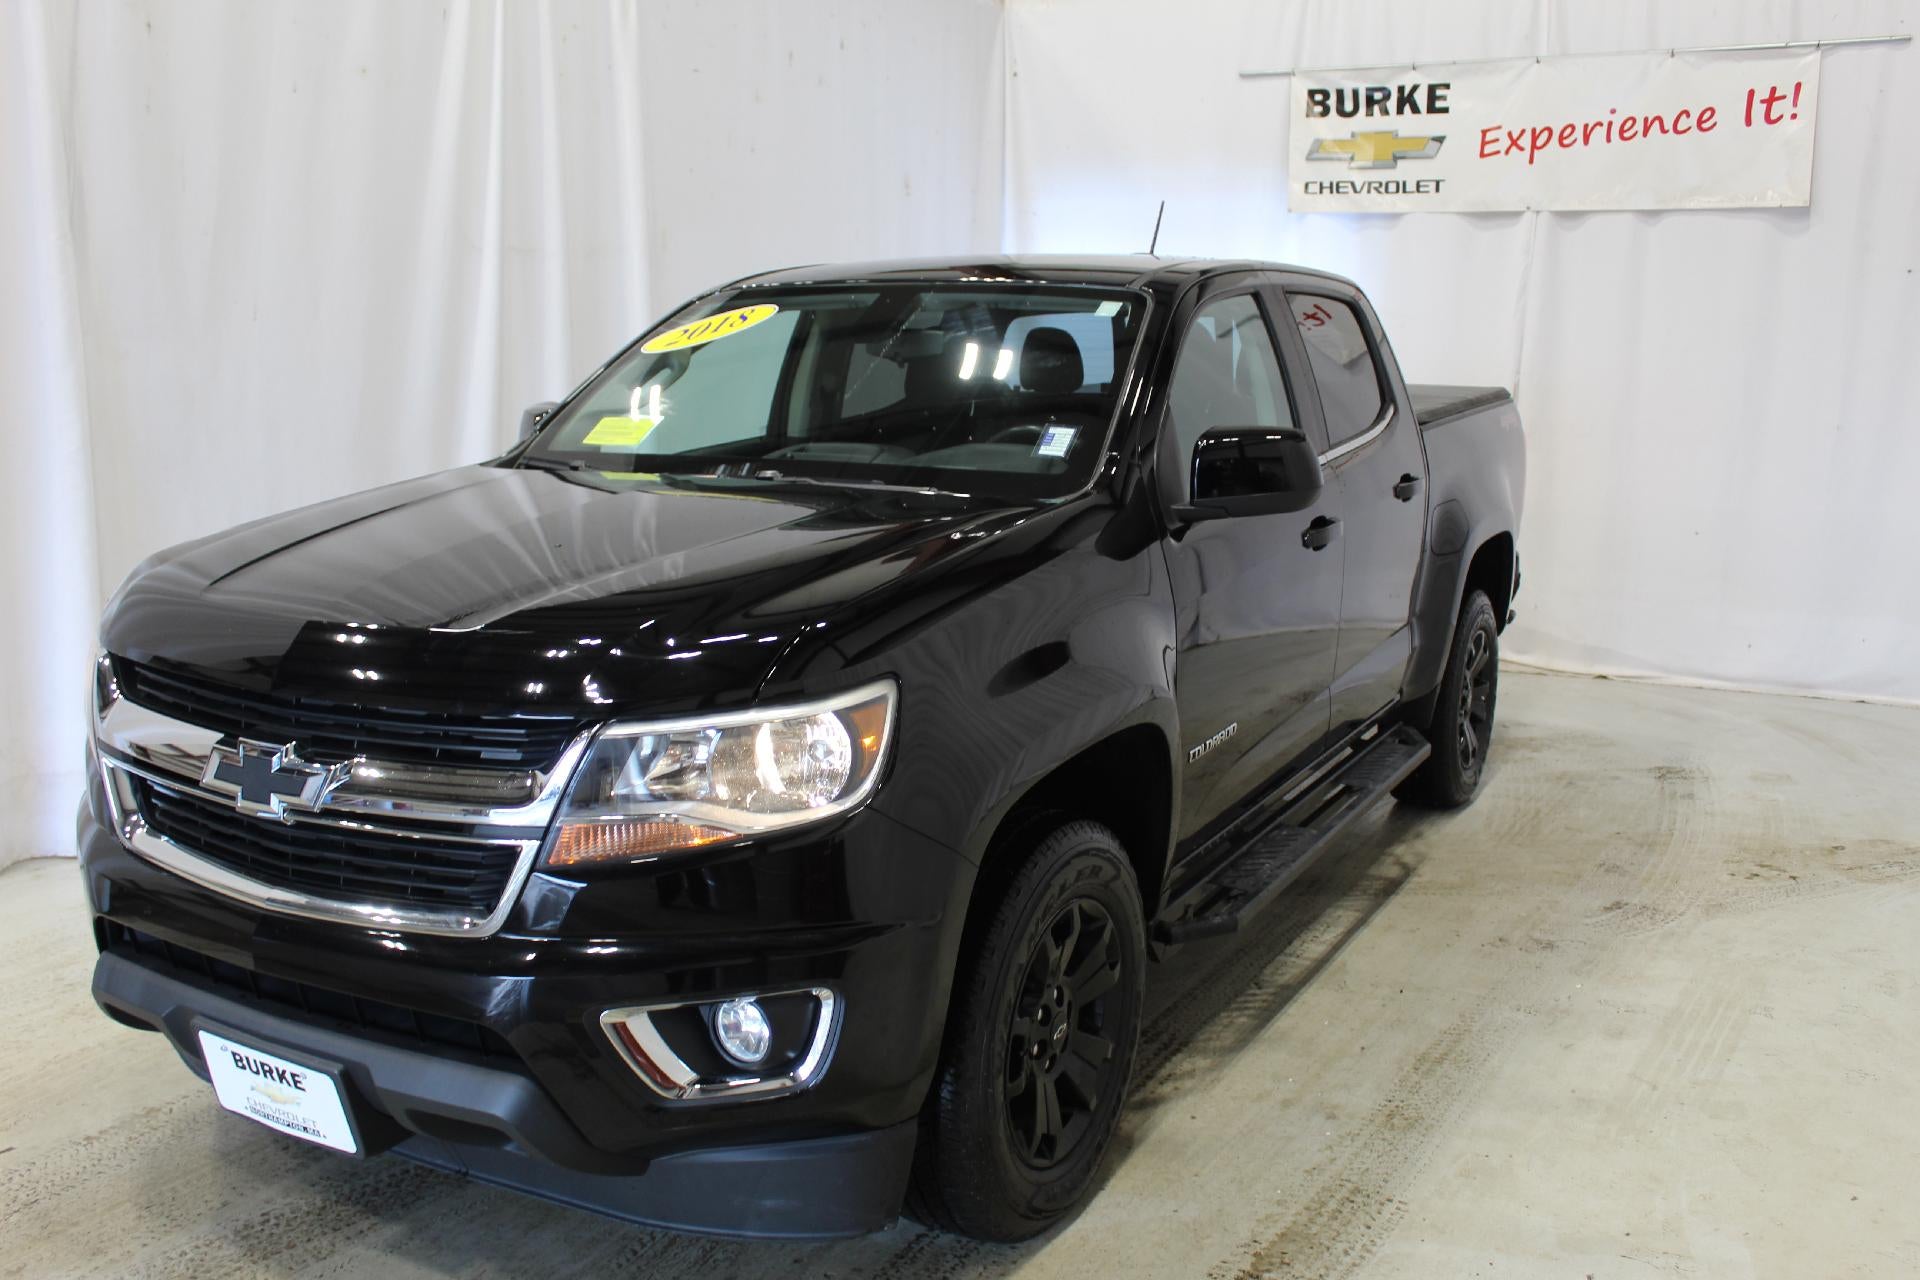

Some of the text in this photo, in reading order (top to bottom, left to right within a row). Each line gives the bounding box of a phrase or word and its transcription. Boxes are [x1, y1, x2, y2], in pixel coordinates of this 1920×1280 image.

[1305, 82, 1452, 119] BURKE
[1478, 81, 1804, 165] Experience It!
[1304, 179, 1447, 196] CHEVROLET
[664, 308, 756, 348] 2018
[231, 1050, 307, 1092] BURKE
